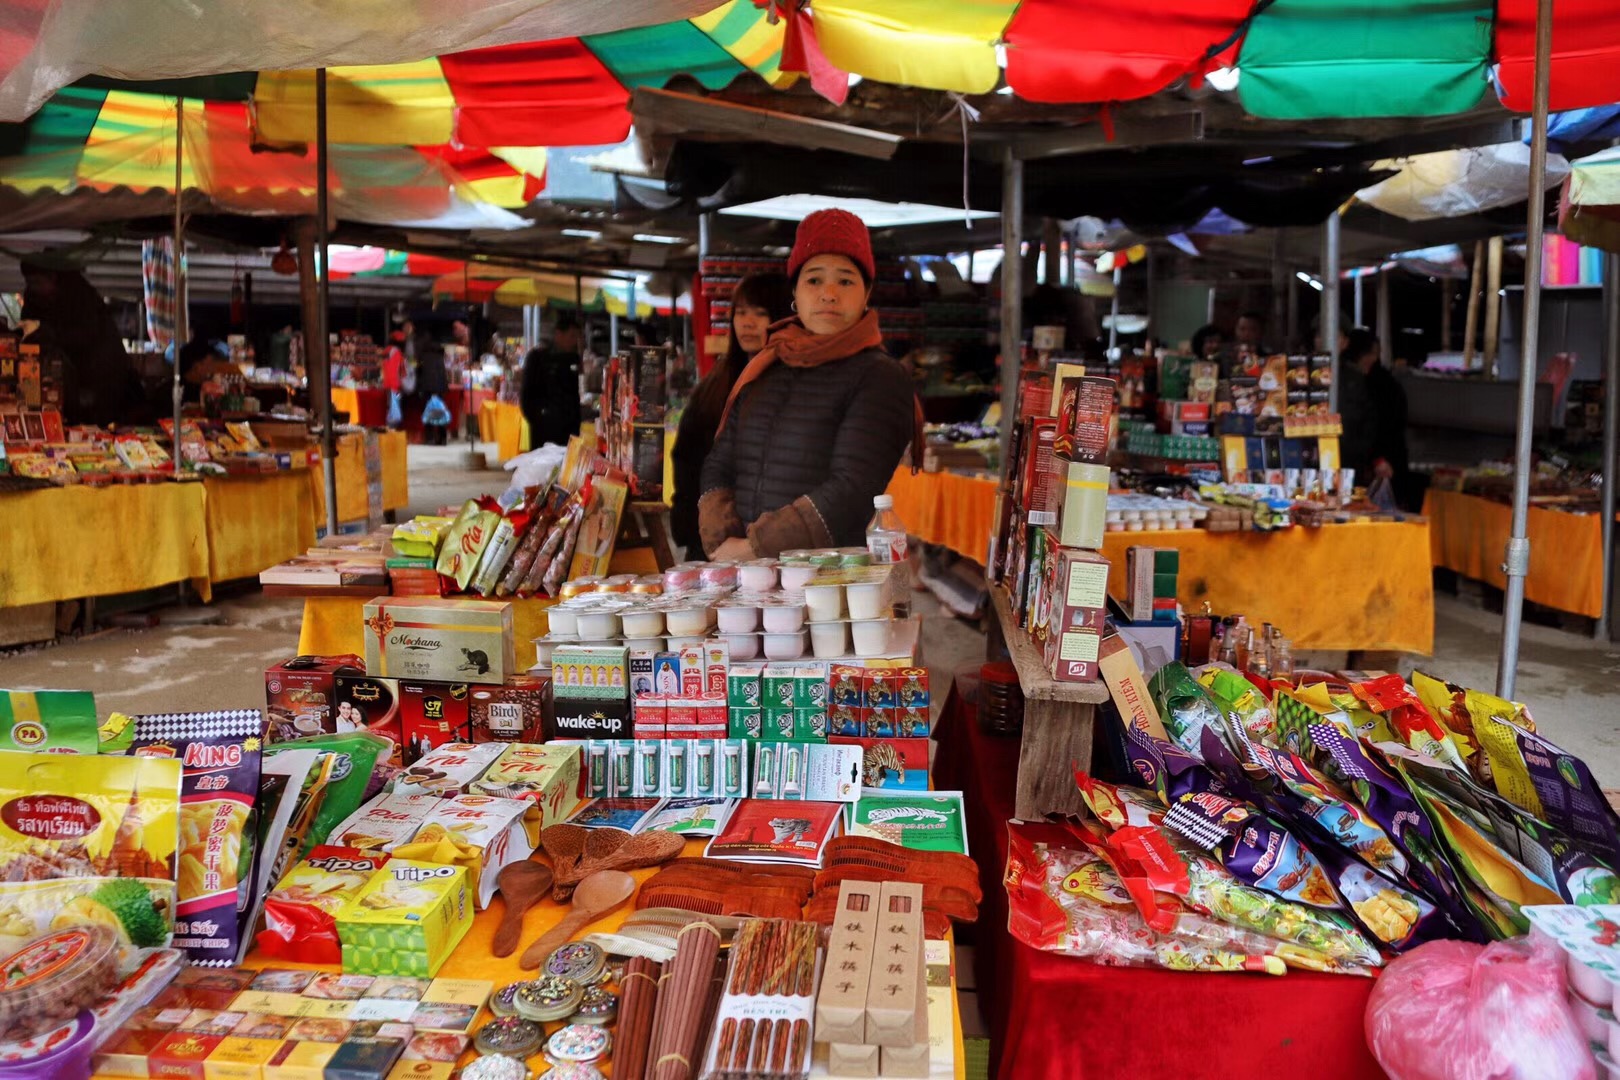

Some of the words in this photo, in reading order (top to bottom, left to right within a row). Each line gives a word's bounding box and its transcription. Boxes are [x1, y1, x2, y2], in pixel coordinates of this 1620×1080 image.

[490, 705, 520, 719] Birdy
[21, 729, 37, 739] PA
[183, 742, 242, 768] KING
[308, 857, 374, 873] Tipo
[391, 866, 456, 882] Tipo
[202, 938, 230, 949] CHIPS
